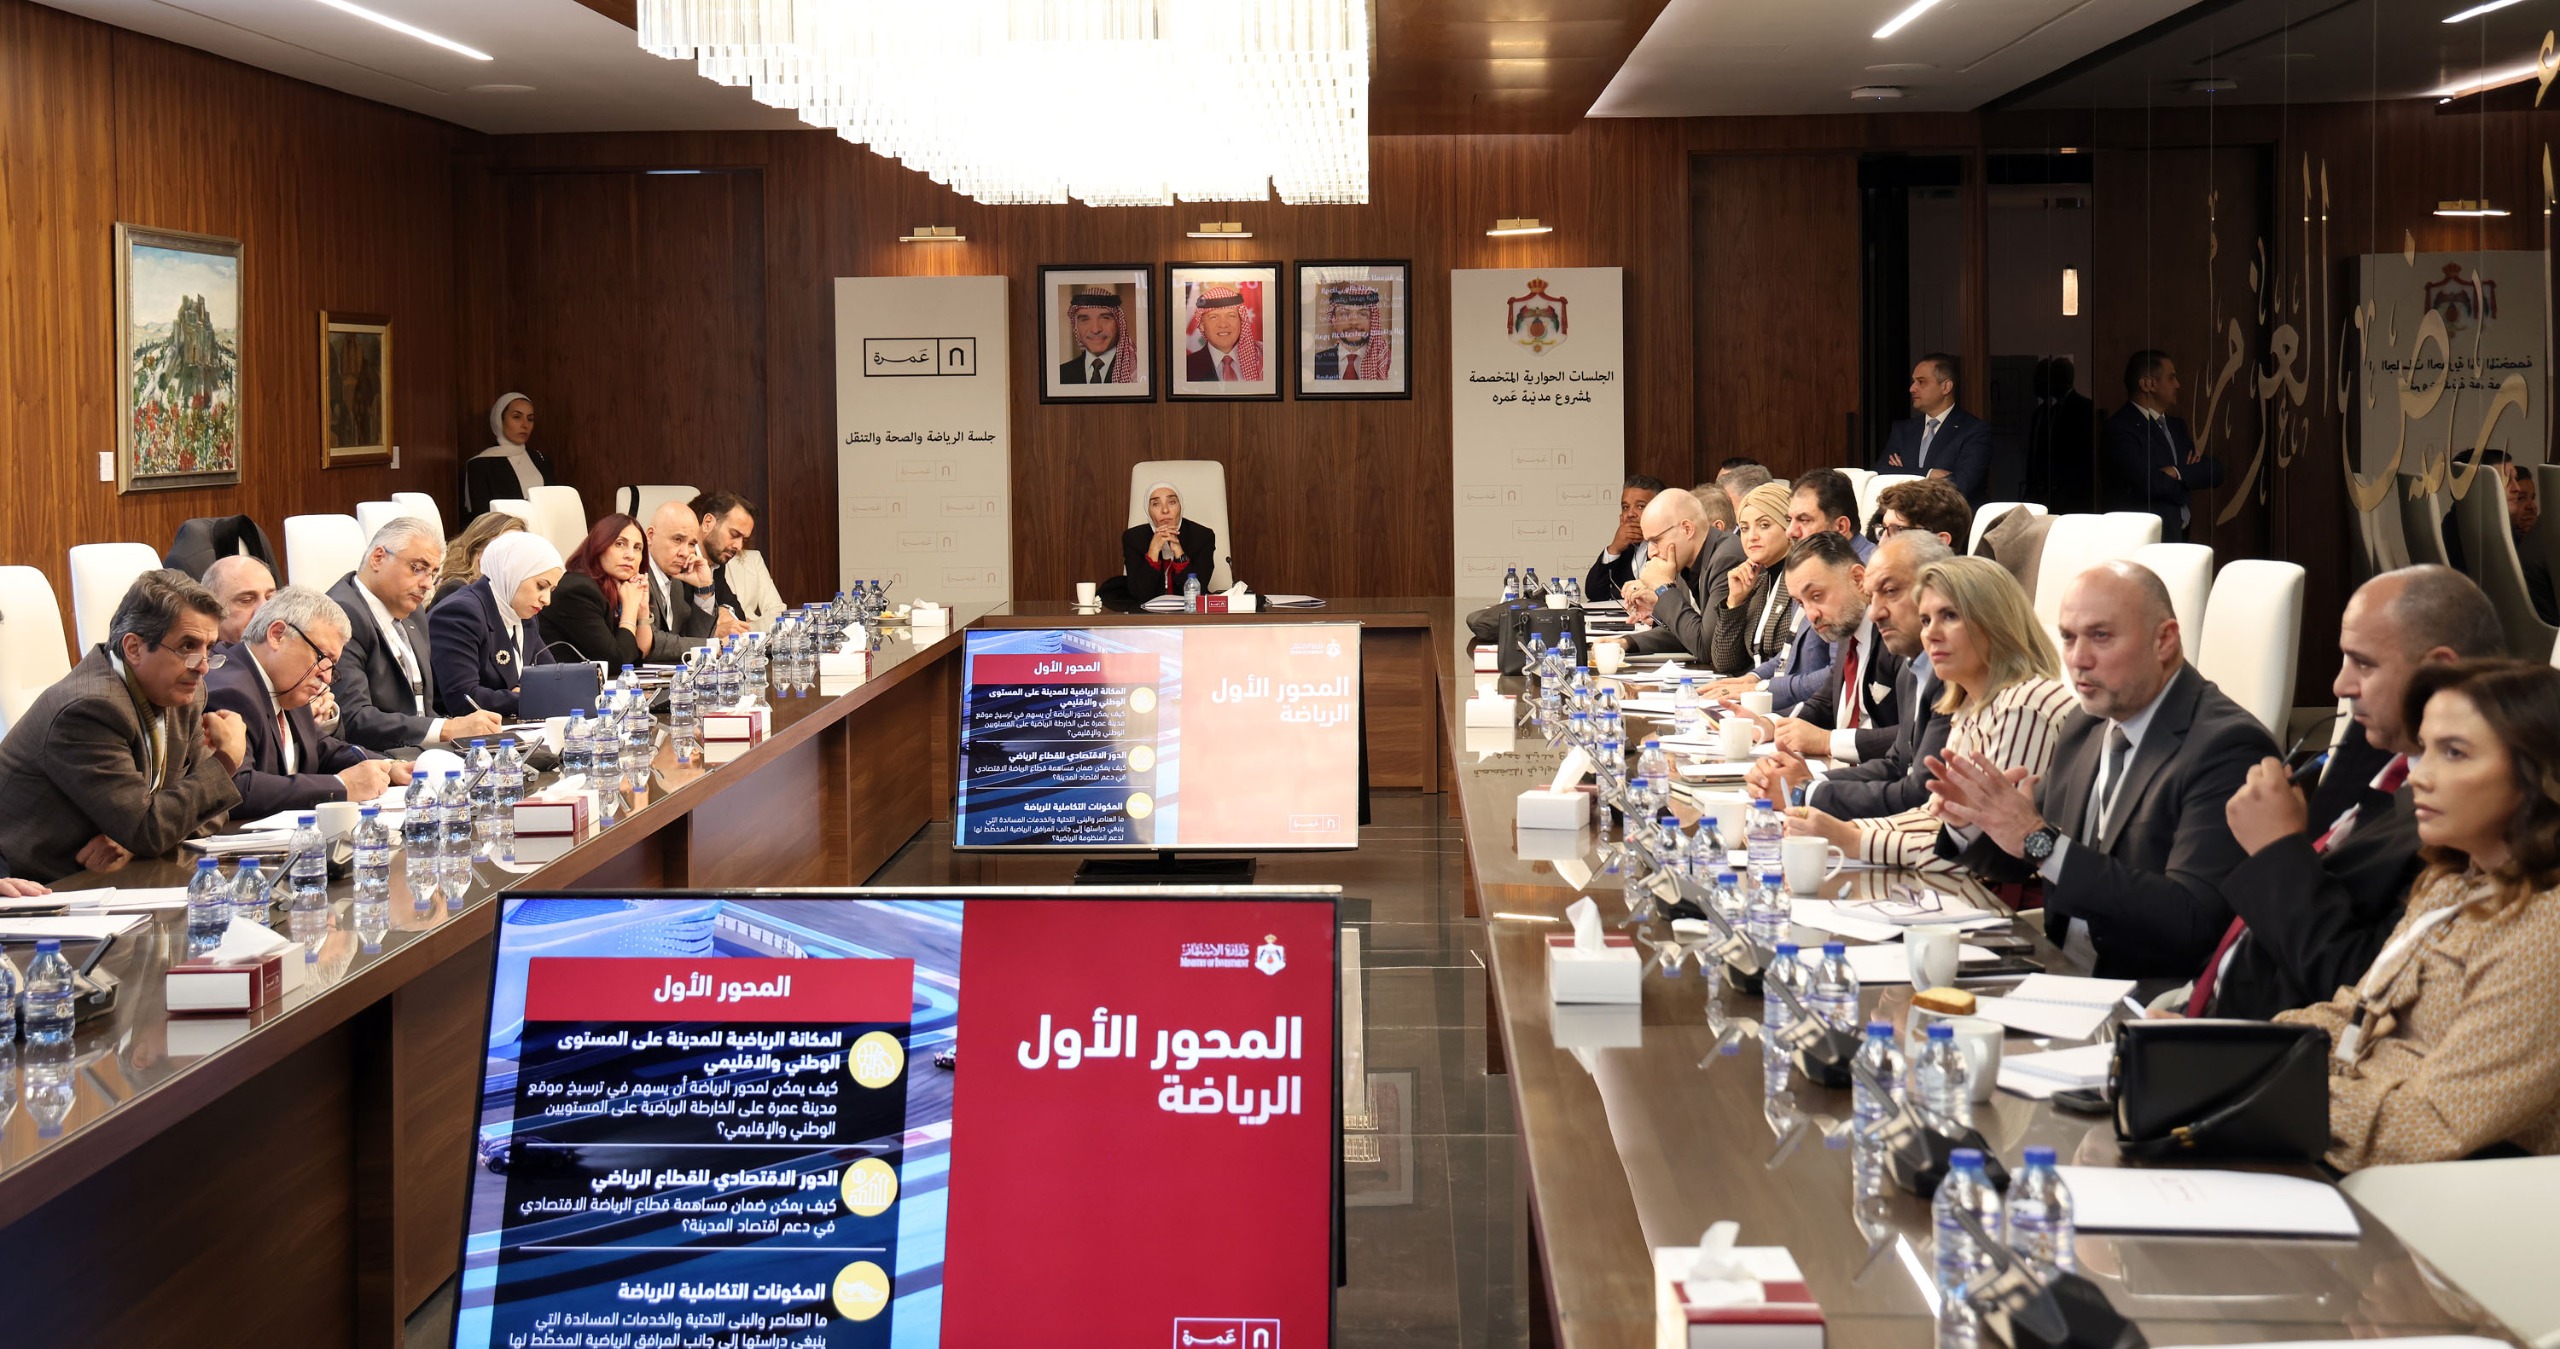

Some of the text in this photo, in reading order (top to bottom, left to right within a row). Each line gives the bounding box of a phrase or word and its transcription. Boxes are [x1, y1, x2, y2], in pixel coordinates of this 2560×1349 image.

[1469, 370, 1614, 385] الجلسات الحوارية المتخصصة
[1555, 390, 1592, 406] لمشروع
[845, 430, 996, 445] جلسة الرياضة والصحة والتنقل
[1034, 661, 1100, 675] المحور الأول
[989, 688, 1126, 698] المكانة الرياضية للمدينة على المستوى
[1212, 674, 1349, 703] المحور الأول
[1099, 698, 1126, 708] الوطني
[1280, 704, 1349, 727] الرياضة
[1008, 751, 1127, 763] الدور الاقتصادي للقطاع الرياضي
[1024, 803, 1123, 812] المكونات التكاملية للرياضة
[654, 973, 791, 1002] المحور الأول
[558, 1031, 842, 1050] المكانة الرياضية للمدينة على المستوى
[1017, 1007, 1302, 1070] المحور الأول
[703, 1054, 840, 1076] الوطني والاقليمي
[527, 1075, 838, 1098] كيف يمكن لمحور الرياضة أن يسهم في ترسيخ موقع
[545, 1100, 837, 1118] مدينة عمرة على الخارطة الرياضية على المستويين
[1158, 1075, 1302, 1125] الرياضة
[717, 1121, 836, 1140] الوطني والإقليمي؟
[591, 1169, 838, 1192] الدور الاقتصادي للقطاع الرياضي
[520, 1197, 836, 1215] كيف يمكن ضمان مساهمة قطاع الرياضة الاقتصادي
[682, 1218, 835, 1238] في دعم اقتصاد المدينة؟
[618, 1283, 825, 1303] المكونات التكاملية للرياضة
[535, 1312, 828, 1330] ما العناصر والبنى التحتية والخدمات المساندة التي
[510, 1334, 526, 1348] لها
[586, 1334, 631, 1349] الرياضية
[634, 1334, 680, 1349] المرافق
[741, 1334, 788, 1349] دراستها
